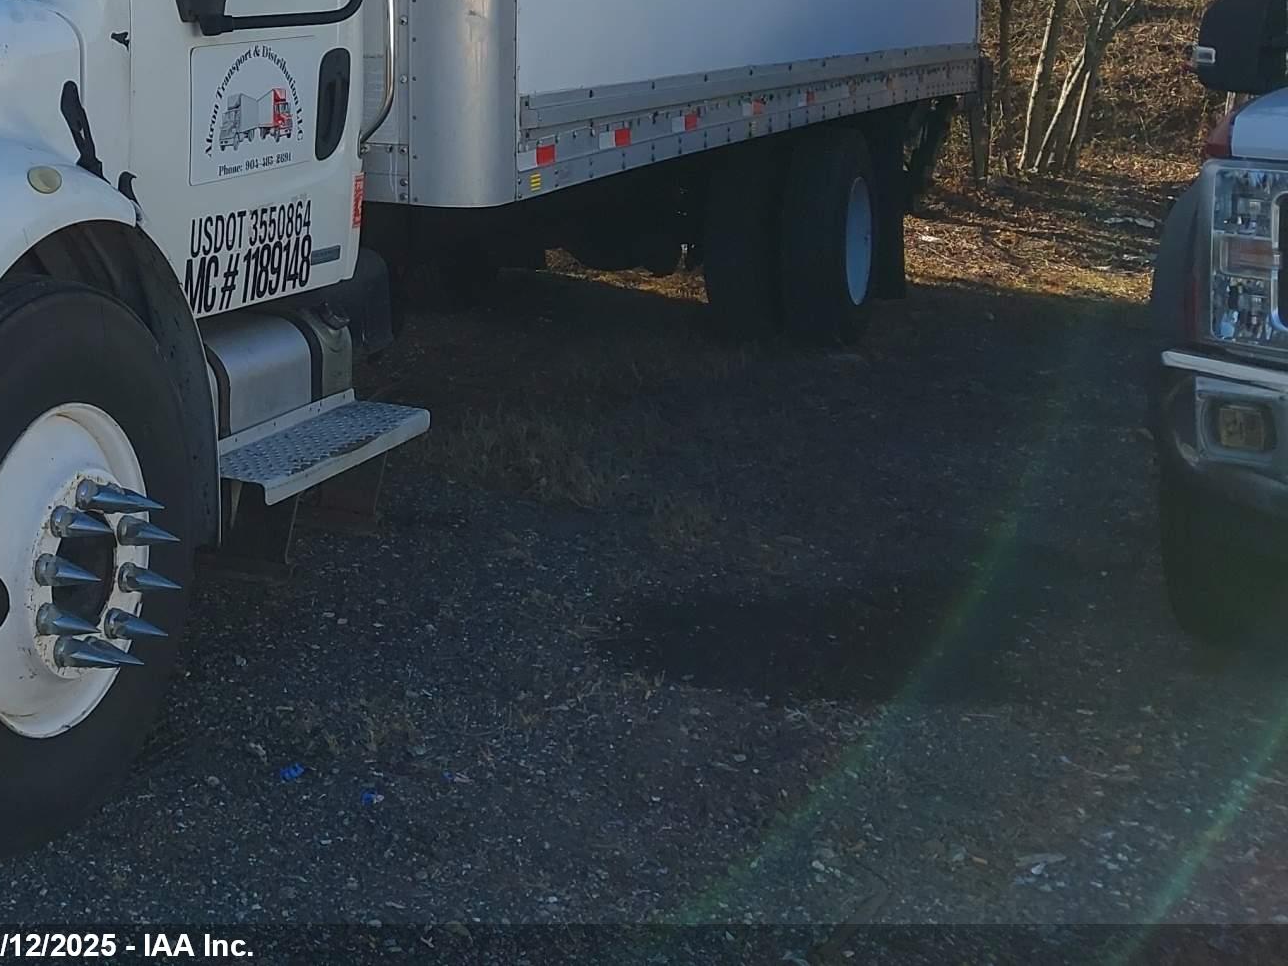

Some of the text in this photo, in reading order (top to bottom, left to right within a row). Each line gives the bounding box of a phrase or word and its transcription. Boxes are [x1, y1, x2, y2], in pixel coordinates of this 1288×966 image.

[215, 47, 252, 101] Transport
[252, 45, 261, 58] &
[261, 45, 300, 107] Distribution
[295, 107, 304, 142] LLC
[218, 163, 243, 177] Phone:
[190, 210, 247, 258] USDOT
[249, 199, 312, 246] 3550864
[184, 234, 312, 314] MC # 1189148
